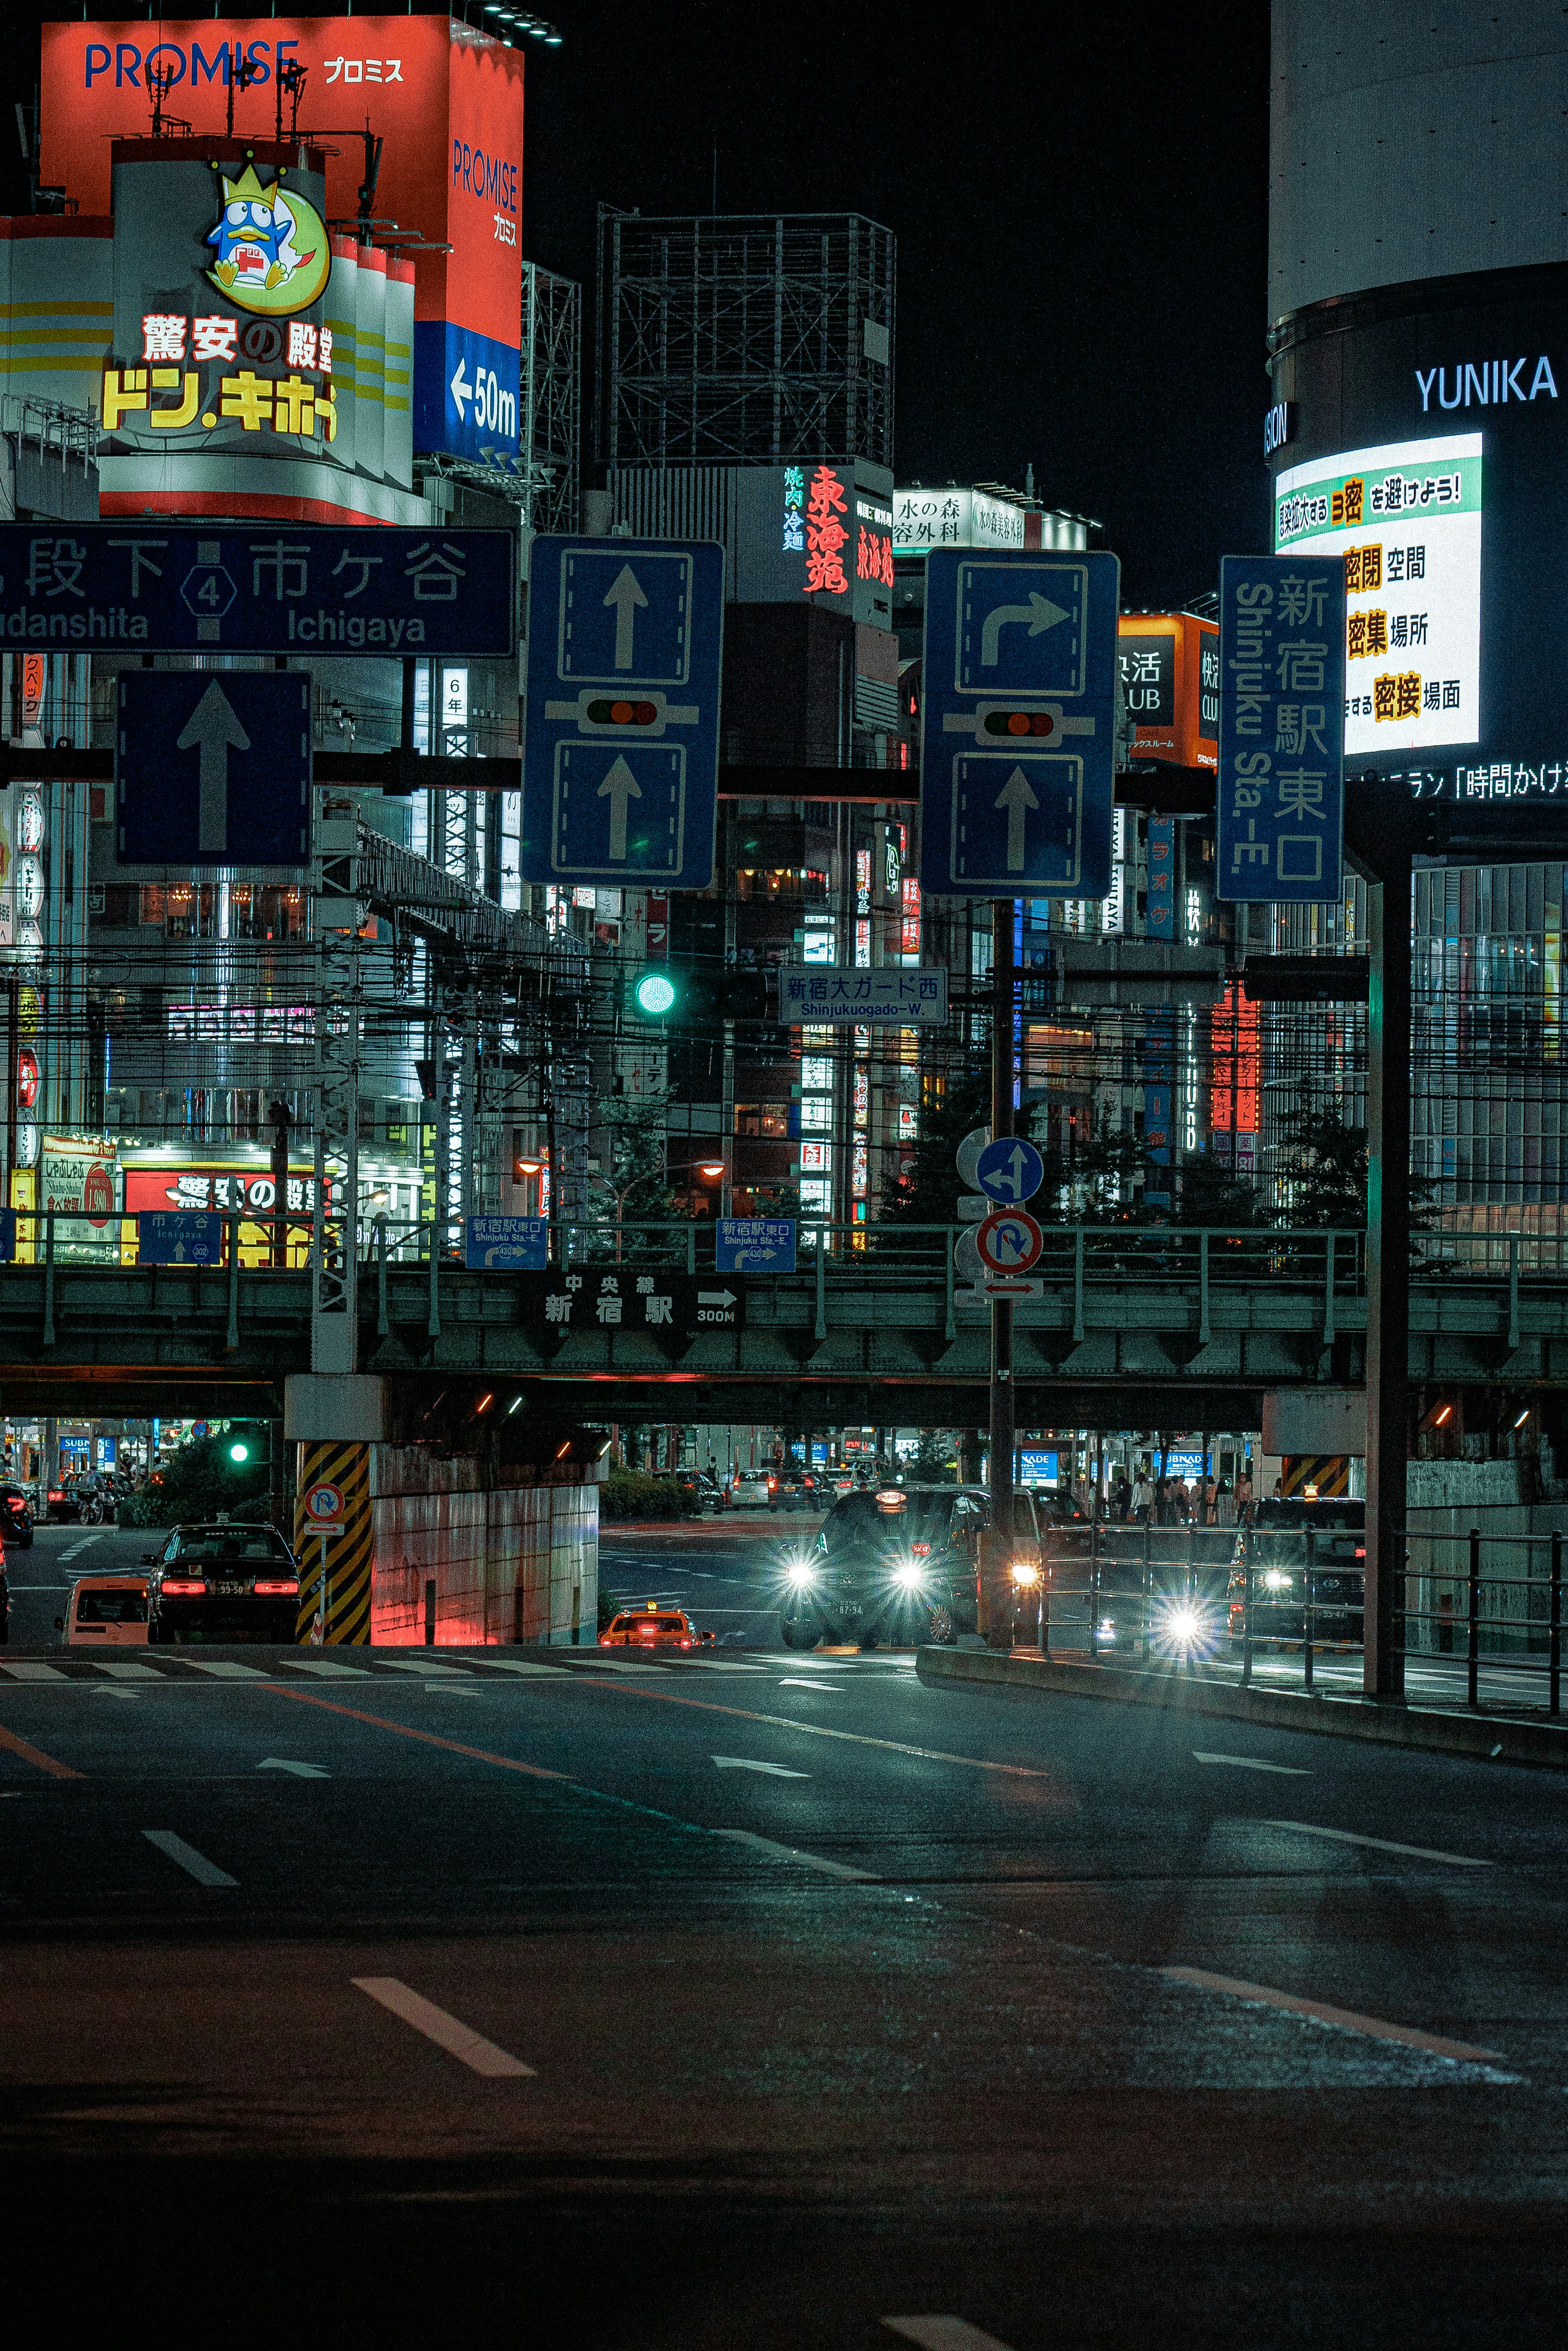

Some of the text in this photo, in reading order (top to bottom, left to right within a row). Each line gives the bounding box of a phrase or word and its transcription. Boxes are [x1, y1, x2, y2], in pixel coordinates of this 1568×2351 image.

[85, 40, 299, 88] PROMISE
[324, 56, 404, 84] プロミス
[453, 138, 517, 212] PROMISE
[493, 211, 517, 247] プロミス
[142, 314, 333, 374] 驚安の殿堂
[1415, 356, 1558, 411] YUNIKA
[474, 366, 515, 438] 50m
[898, 497, 960, 520] 水の森
[803, 465, 850, 593] 東海苑
[893, 521, 960, 543] 容外科
[0, 538, 168, 598] 段下
[857, 525, 894, 588] 東海苑
[198, 575, 220, 607] 4
[288, 609, 425, 648] Ichigaya
[1229, 582, 1274, 735] Shinjuku
[1274, 574, 1329, 882] 新宿駅東口
[787, 976, 938, 1000] 新宿大ガード西
[46, 1158, 84, 1179] しゃぶしゃぶ
[472, 1218, 541, 1233] 新宿駅東口
[475, 1233, 509, 1242] Shinjuku
[722, 1221, 789, 1236] 新宿駅東口
[194, 1247, 207, 1256] 302
[500, 1247, 511, 1255] 430
[724, 1236, 757, 1246] Shinjuku
[566, 1274, 655, 1294] 中央線
[545, 1294, 673, 1324] 新宿駅
[697, 1310, 735, 1323] 300M
[220, 1586, 243, 1594] 99-50
[839, 1606, 862, 1615] 87-94
